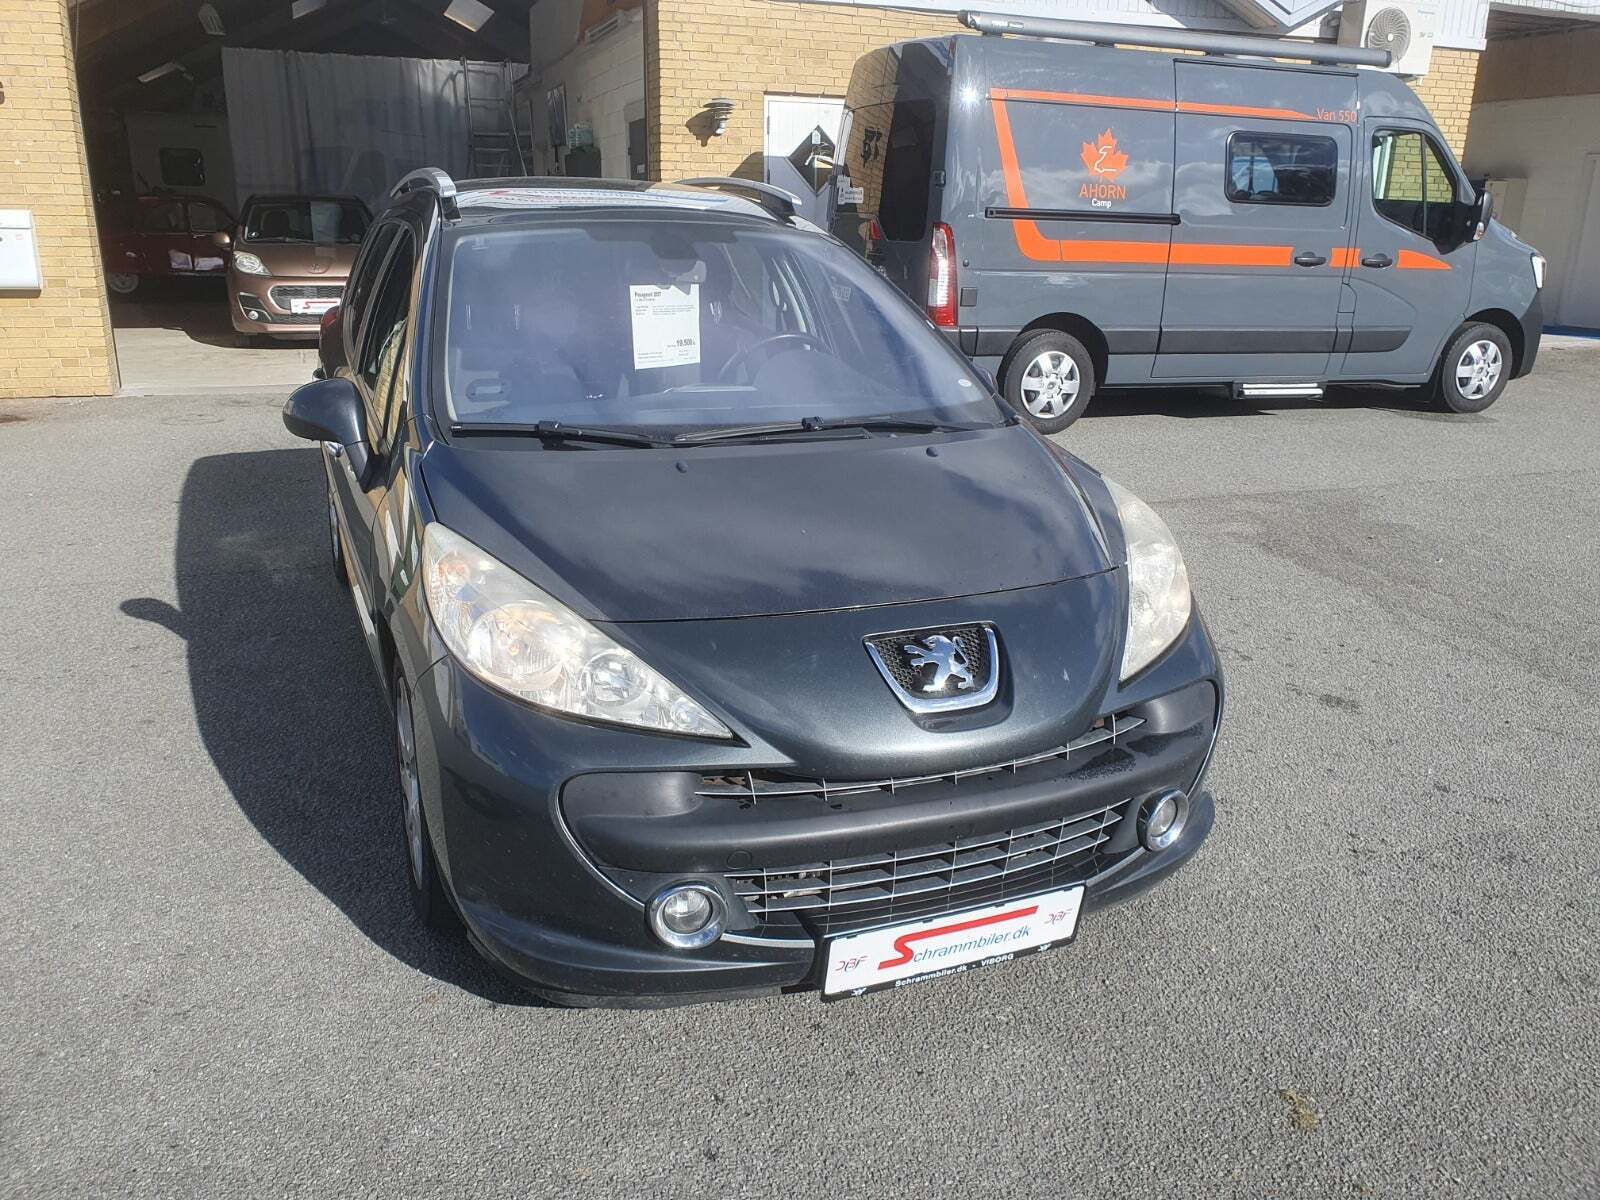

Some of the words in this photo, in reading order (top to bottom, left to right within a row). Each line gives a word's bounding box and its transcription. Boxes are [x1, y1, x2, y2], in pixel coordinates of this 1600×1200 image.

[1316, 107, 1336, 121] Van
[1338, 110, 1357, 122] 550
[1079, 183, 1127, 200] AHORN
[1091, 198, 1112, 209] Camp
[877, 905, 1039, 970] Schrammbiler.dk
[895, 964, 968, 988] Schrammbiler.dk
[981, 953, 1014, 967] VIBORG
